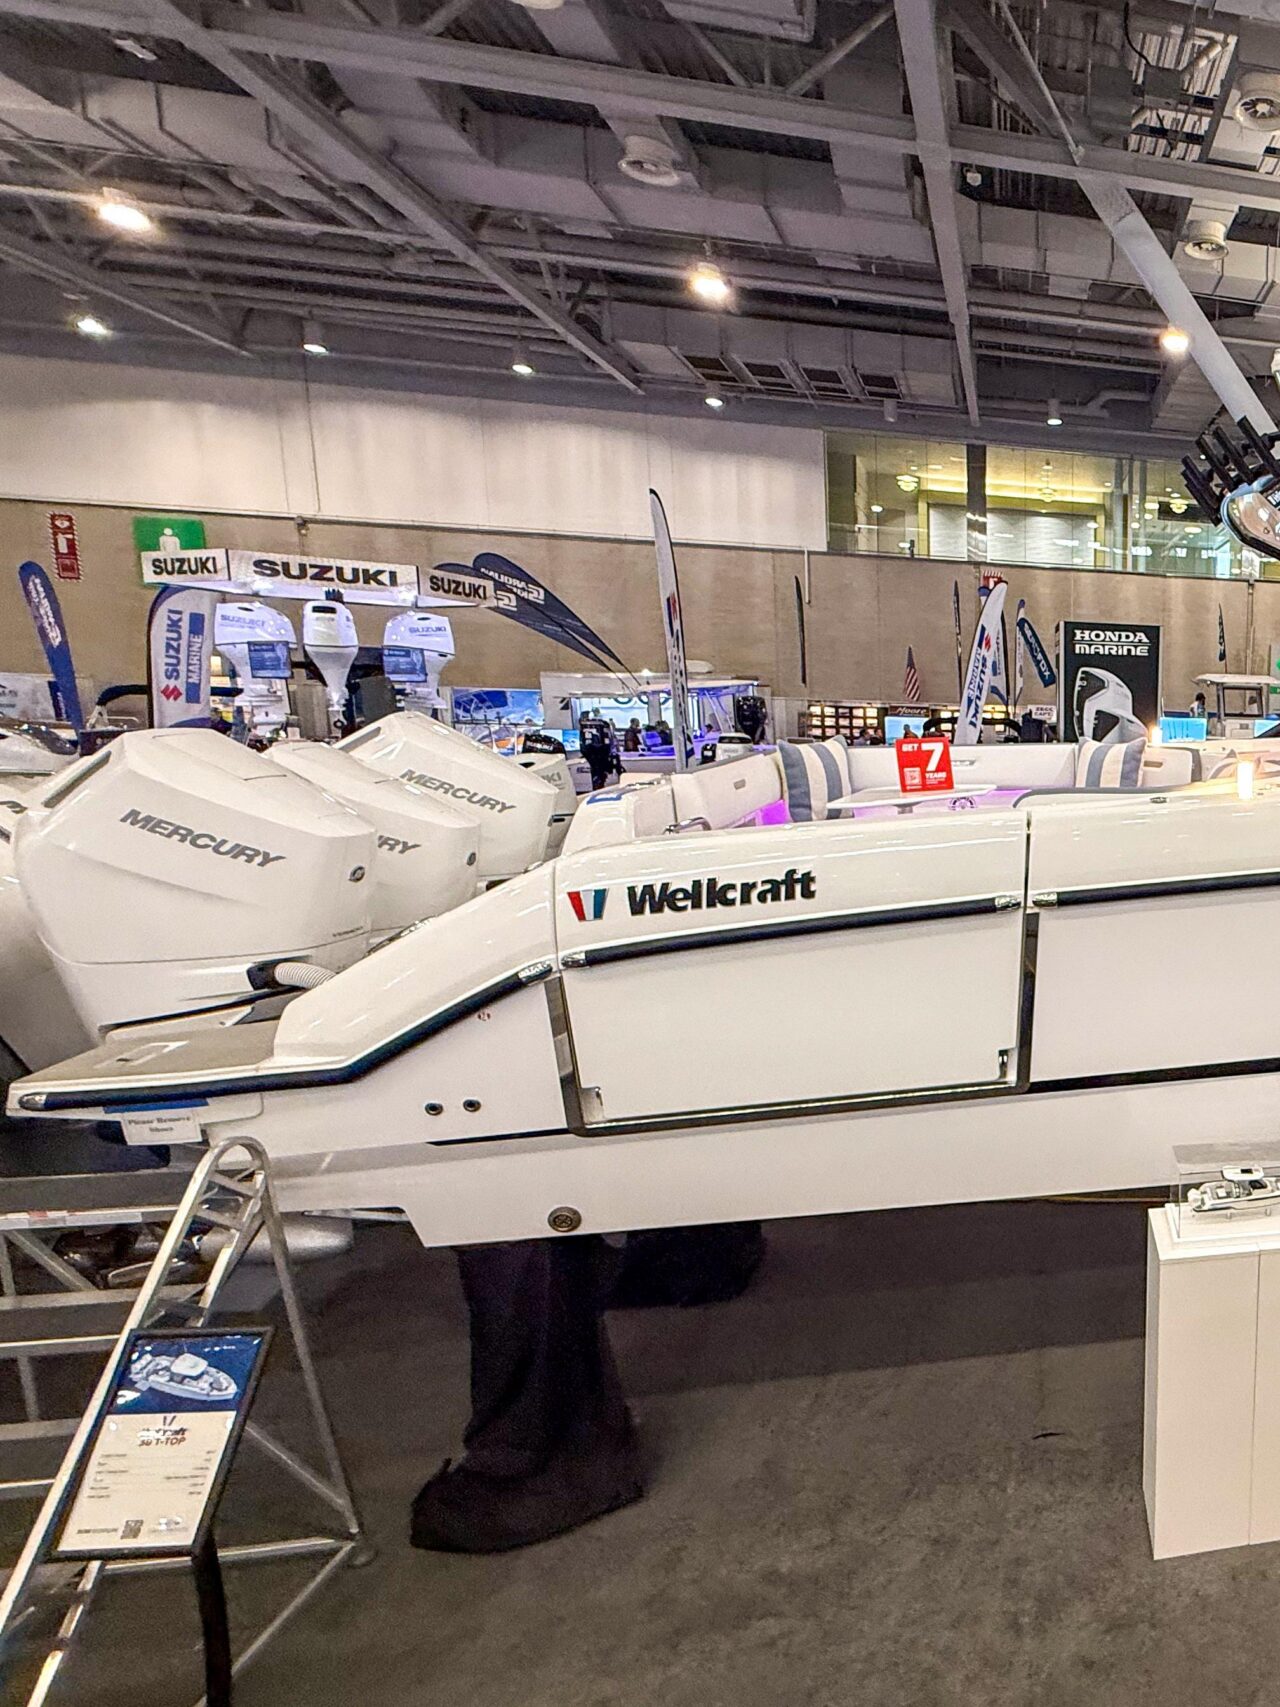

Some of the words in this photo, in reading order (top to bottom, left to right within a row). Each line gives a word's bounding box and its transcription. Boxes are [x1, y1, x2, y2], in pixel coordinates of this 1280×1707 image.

[152, 556, 218, 576] SUZUKI
[253, 559, 398, 587] SUZUKI
[429, 575, 487, 601] SUZUKI
[165, 608, 183, 681] SUZUKI
[408, 625, 447, 634] SUZUKI
[1074, 629, 1150, 643] HONDA
[186, 633, 203, 684] MARINE
[969, 655, 987, 728] SUZUKI
[902, 743, 919, 752] GET
[921, 742, 944, 771] 7
[400, 768, 517, 814] MERCURY
[120, 808, 286, 868] MERCURY
[627, 868, 817, 917] Wellcraft
